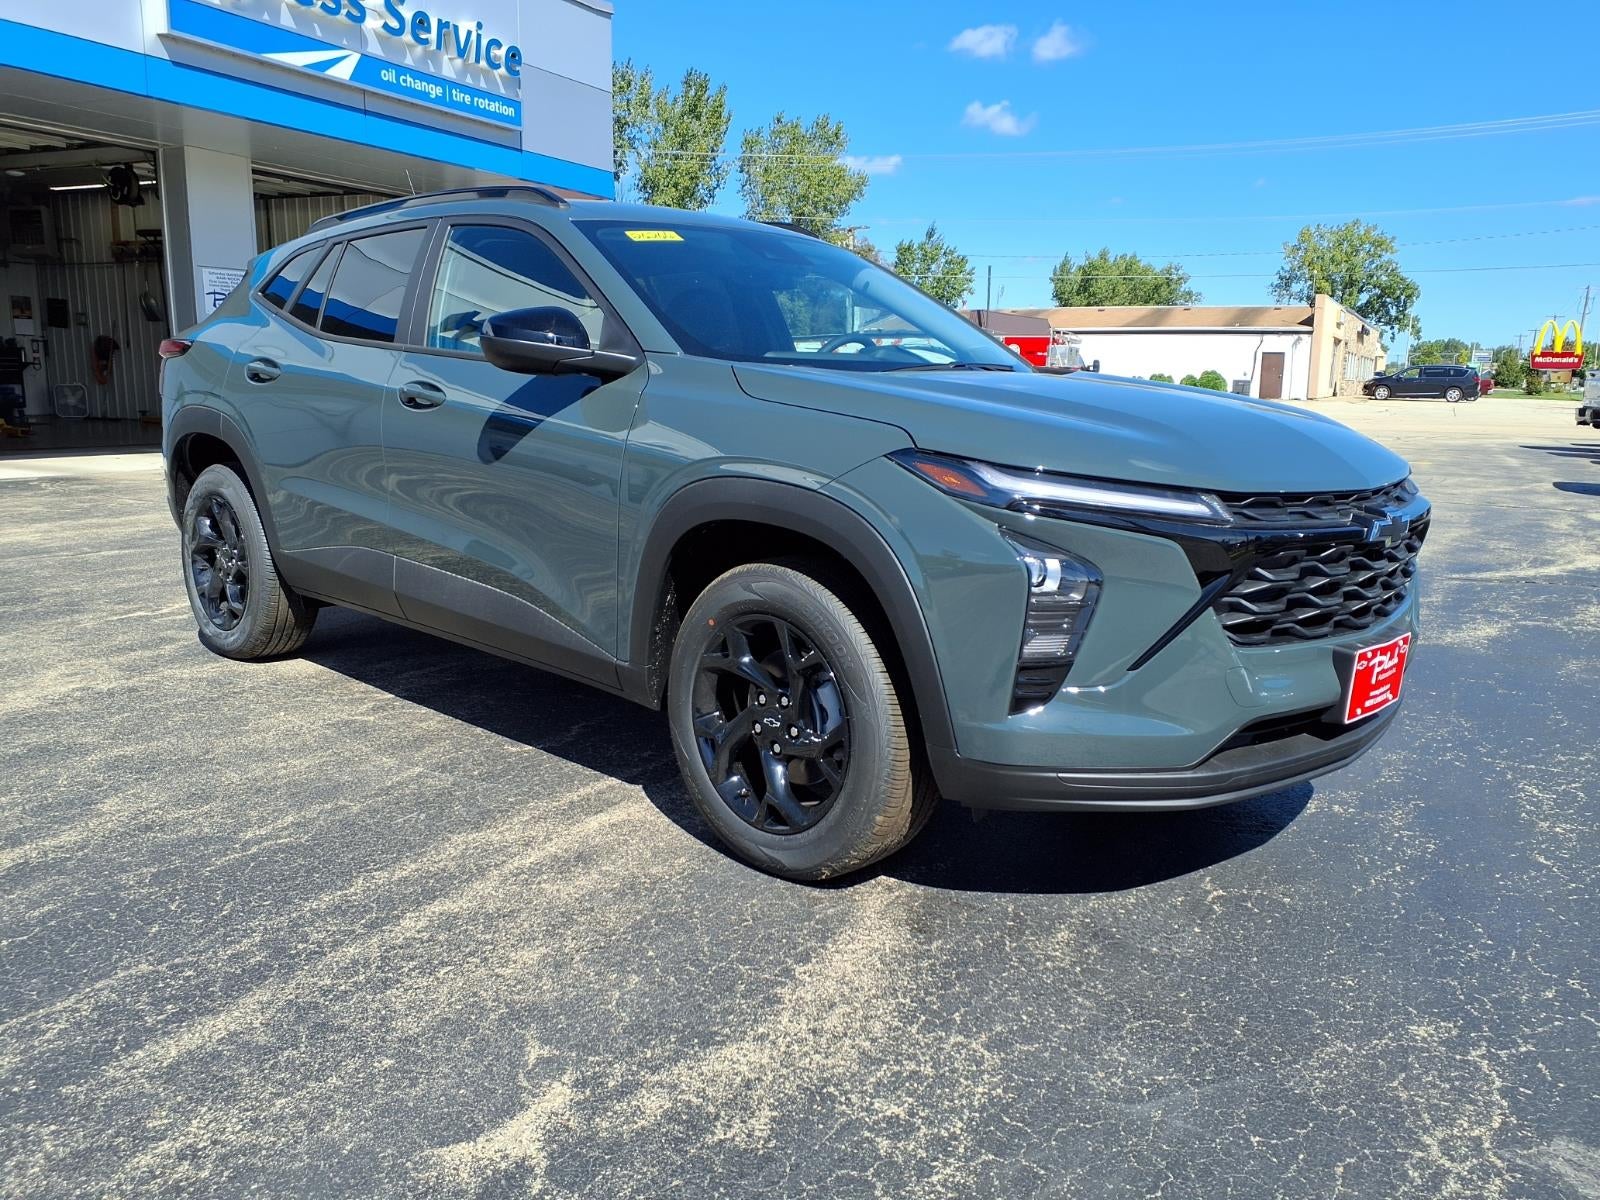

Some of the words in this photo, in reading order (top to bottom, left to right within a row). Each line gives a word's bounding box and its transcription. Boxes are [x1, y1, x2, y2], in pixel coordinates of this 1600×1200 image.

[382, 0, 522, 76] Service
[381, 68, 397, 84] oil
[400, 74, 443, 98] change
[452, 88, 471, 105] tire
[474, 96, 515, 117] rotation
